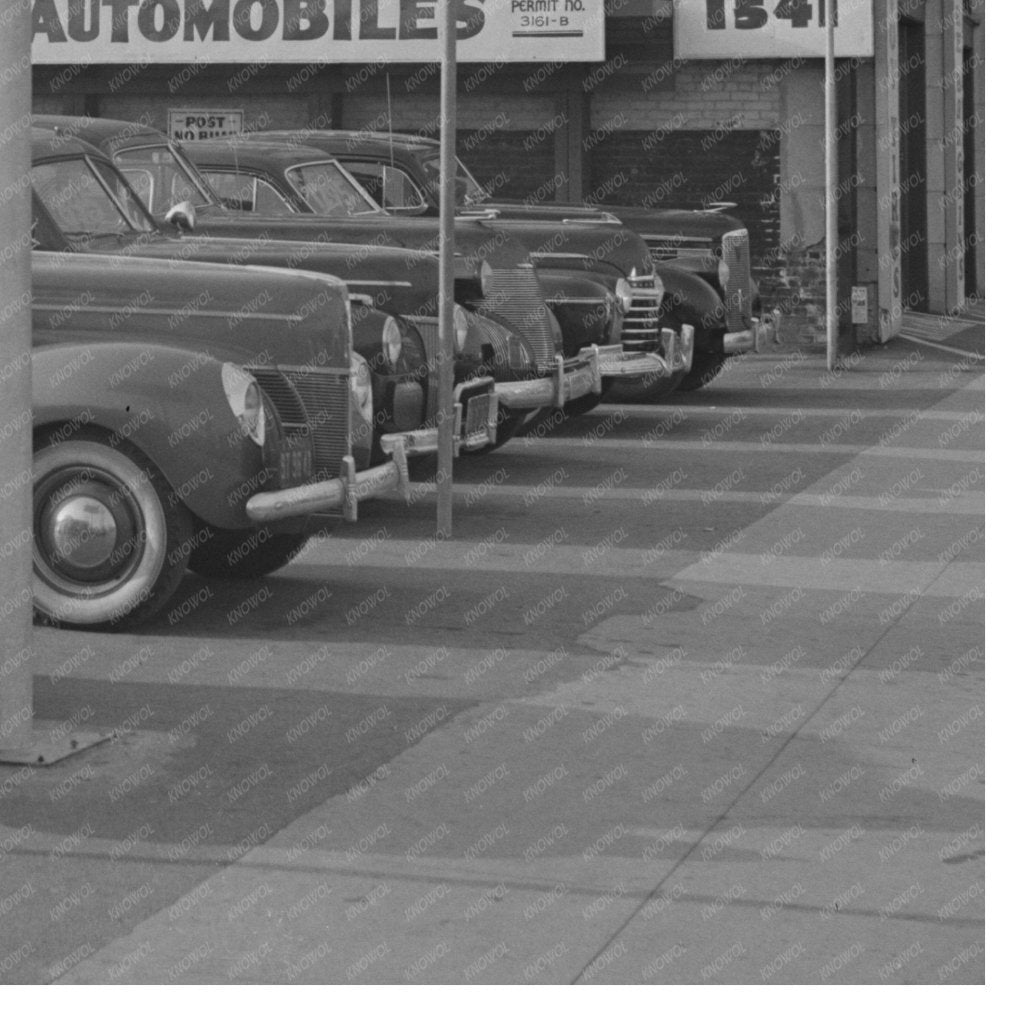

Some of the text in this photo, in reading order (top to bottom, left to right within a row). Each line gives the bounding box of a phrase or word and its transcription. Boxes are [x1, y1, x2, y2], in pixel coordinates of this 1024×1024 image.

[511, 0, 586, 12] PERMIT NO.
[520, 16, 569, 27] 3161-B
[185, 116, 226, 128] POST
